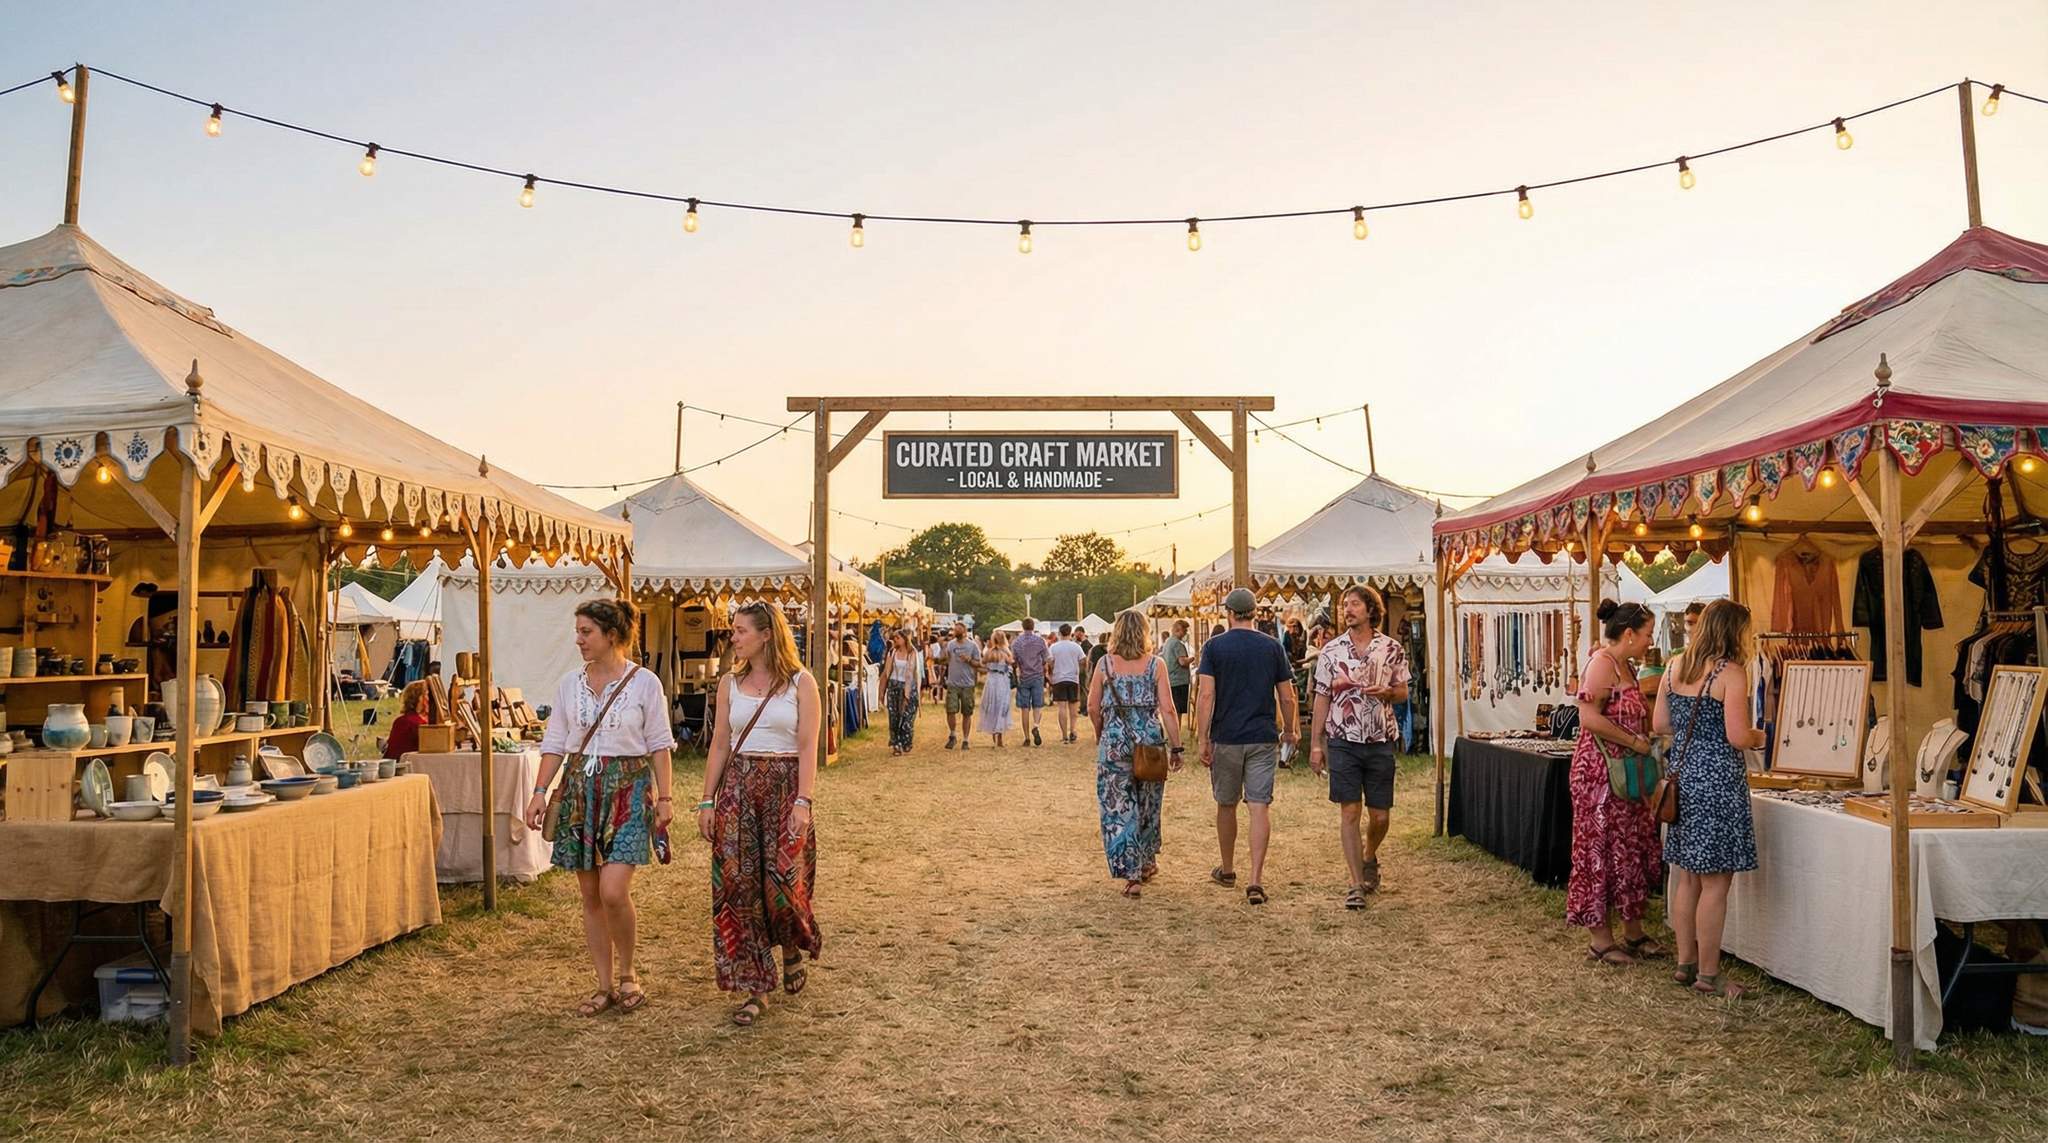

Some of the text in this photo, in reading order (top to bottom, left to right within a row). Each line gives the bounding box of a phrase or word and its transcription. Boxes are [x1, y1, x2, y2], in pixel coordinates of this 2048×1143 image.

[896, 441, 1166, 468] CURATED CRAFT MARKET
[959, 471, 1004, 488] LOCAL
[1007, 471, 1020, 488] &
[1023, 471, 1103, 488] HANDMADE
